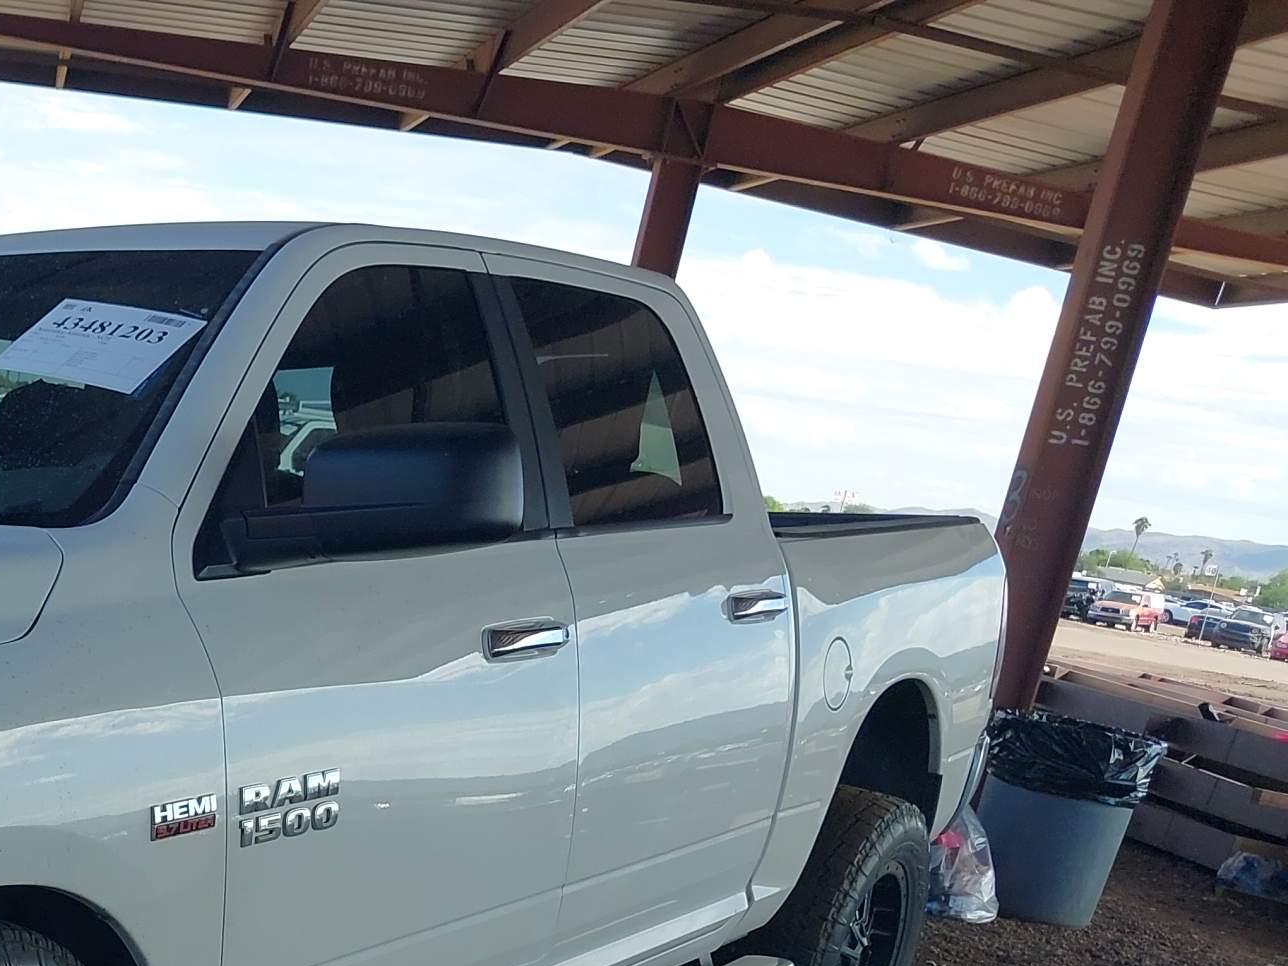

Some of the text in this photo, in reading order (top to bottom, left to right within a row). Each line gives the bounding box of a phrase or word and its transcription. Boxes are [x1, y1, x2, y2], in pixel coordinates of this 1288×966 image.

[52, 315, 169, 345] 43481203
[1047, 239, 1126, 445] U.S. PREFAB INC.
[1071, 243, 1145, 446] 1-866-799-0969
[153, 794, 217, 824] HEMI
[239, 768, 340, 815] RAM
[239, 800, 339, 848] 1500
